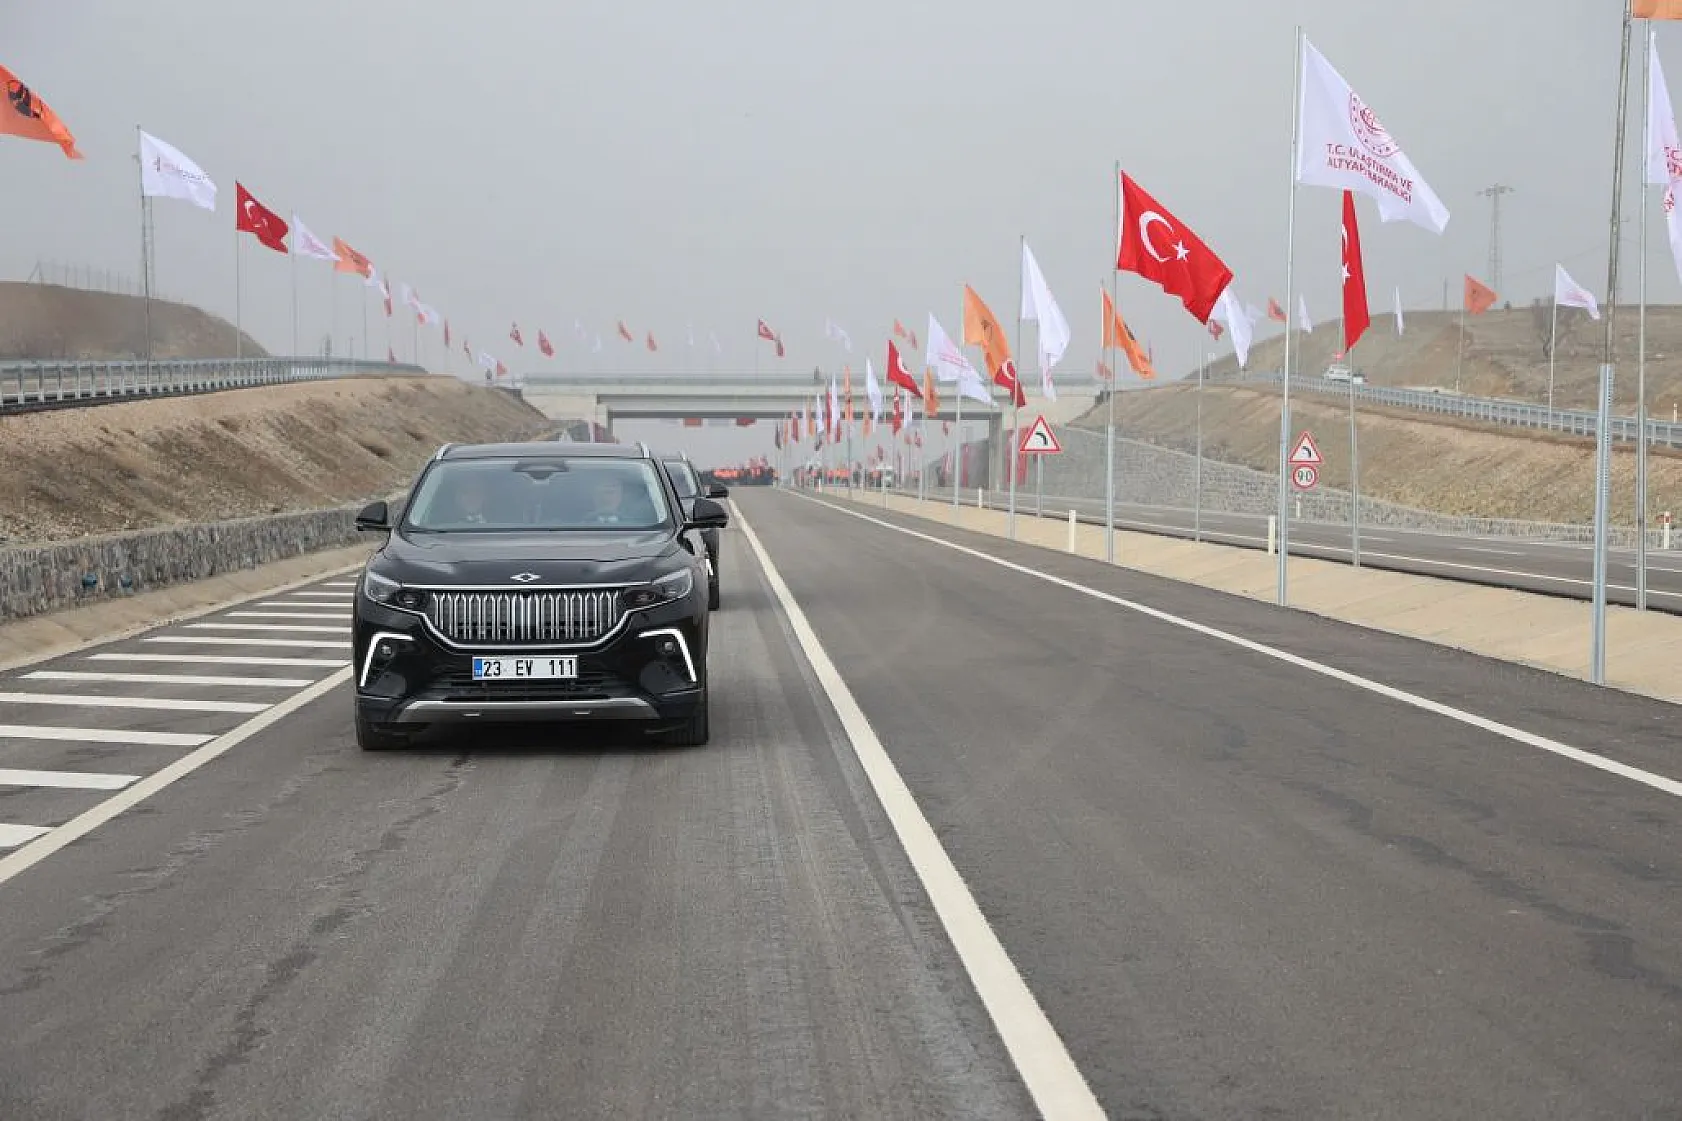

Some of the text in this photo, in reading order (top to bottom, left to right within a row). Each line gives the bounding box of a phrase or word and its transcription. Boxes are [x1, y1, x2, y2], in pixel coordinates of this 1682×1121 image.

[1326, 143, 1346, 155] T.C.
[1400, 177, 1413, 191] VE
[483, 661, 501, 677] 23
[516, 659, 533, 676] EV
[548, 659, 573, 676] 111
